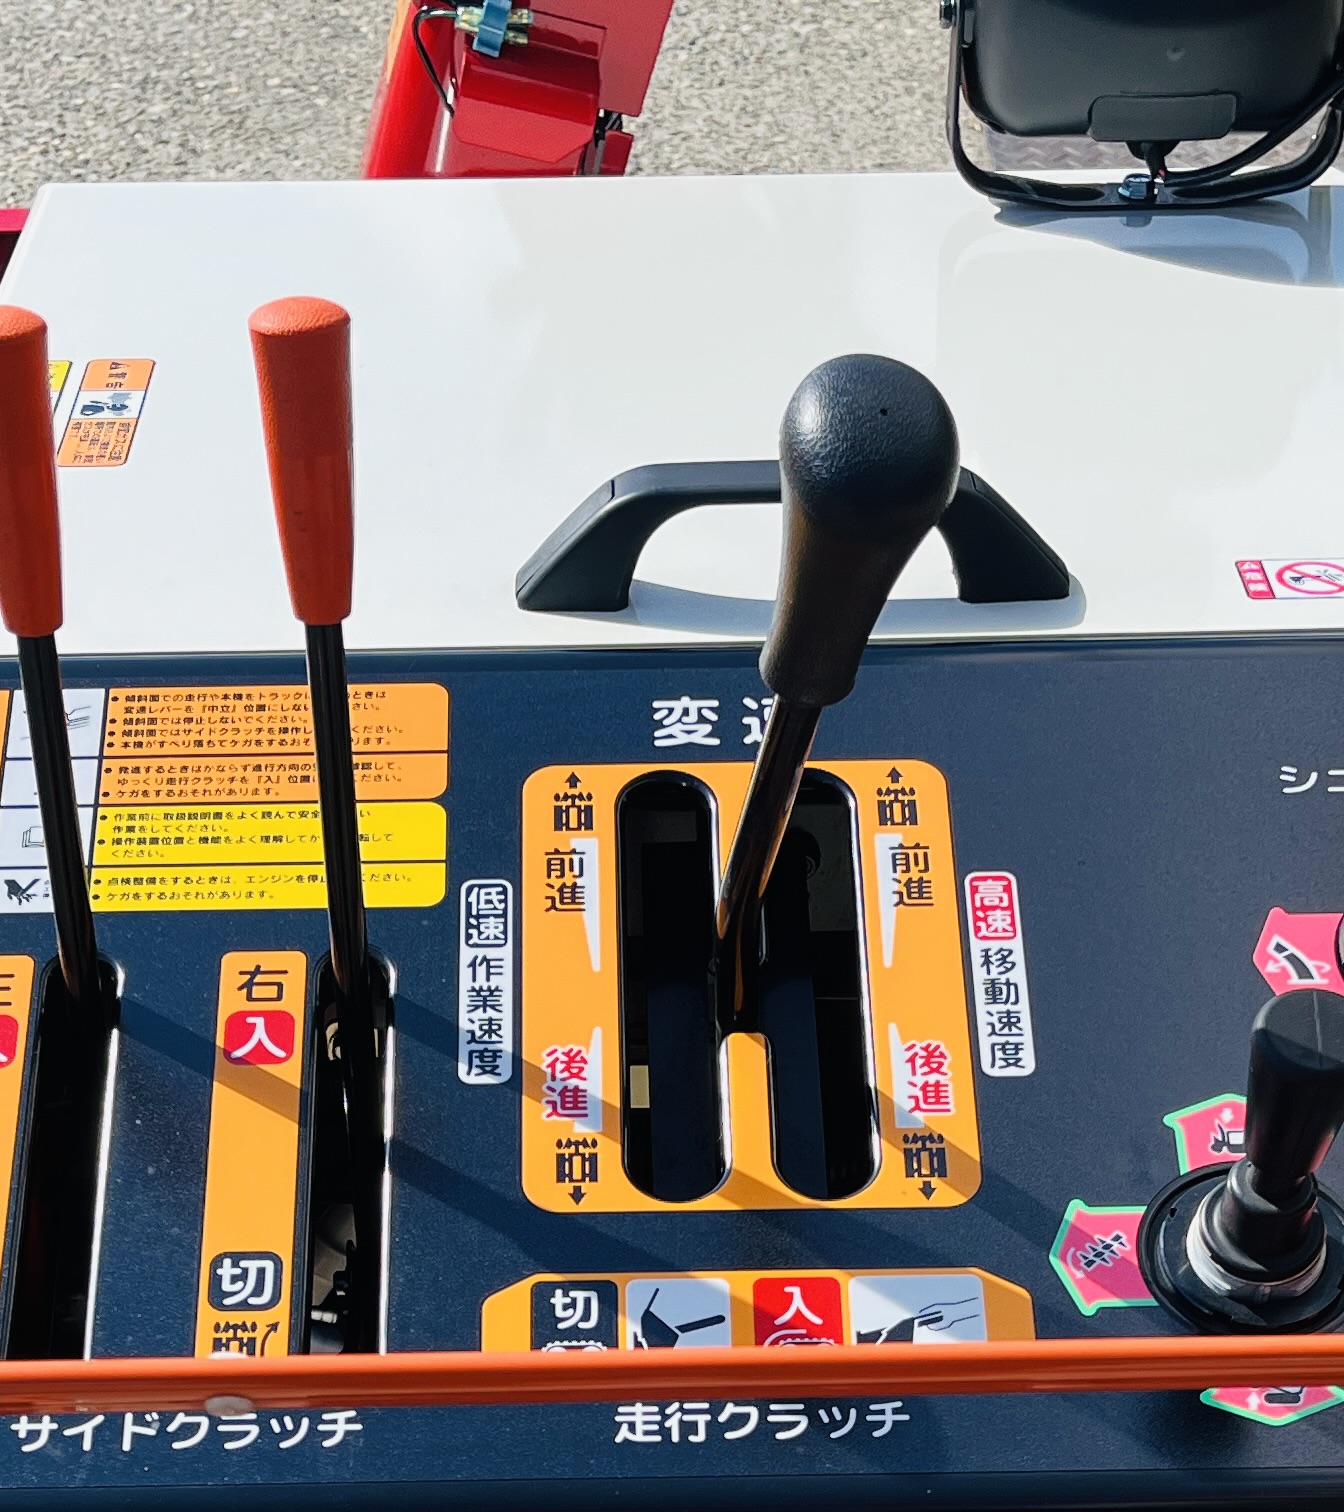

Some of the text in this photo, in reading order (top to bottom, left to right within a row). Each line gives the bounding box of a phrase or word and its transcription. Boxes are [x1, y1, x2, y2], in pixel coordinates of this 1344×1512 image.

[544, 847, 587, 913] 前進
[888, 842, 935, 908] 前進
[236, 965, 288, 1003] 右
[466, 885, 507, 1077] 低速 作業速度
[972, 879, 1026, 1071] 高速 移動速度
[231, 1017, 286, 1058] 入
[544, 1046, 588, 1119] 後進
[904, 1041, 952, 1115] 後進
[216, 1260, 275, 1306] 切
[774, 1286, 824, 1326] 入
[550, 1290, 599, 1330] 切
[10, 1410, 363, 1452] サイドクラッチ
[614, 1401, 910, 1443] 走行クラッチ
